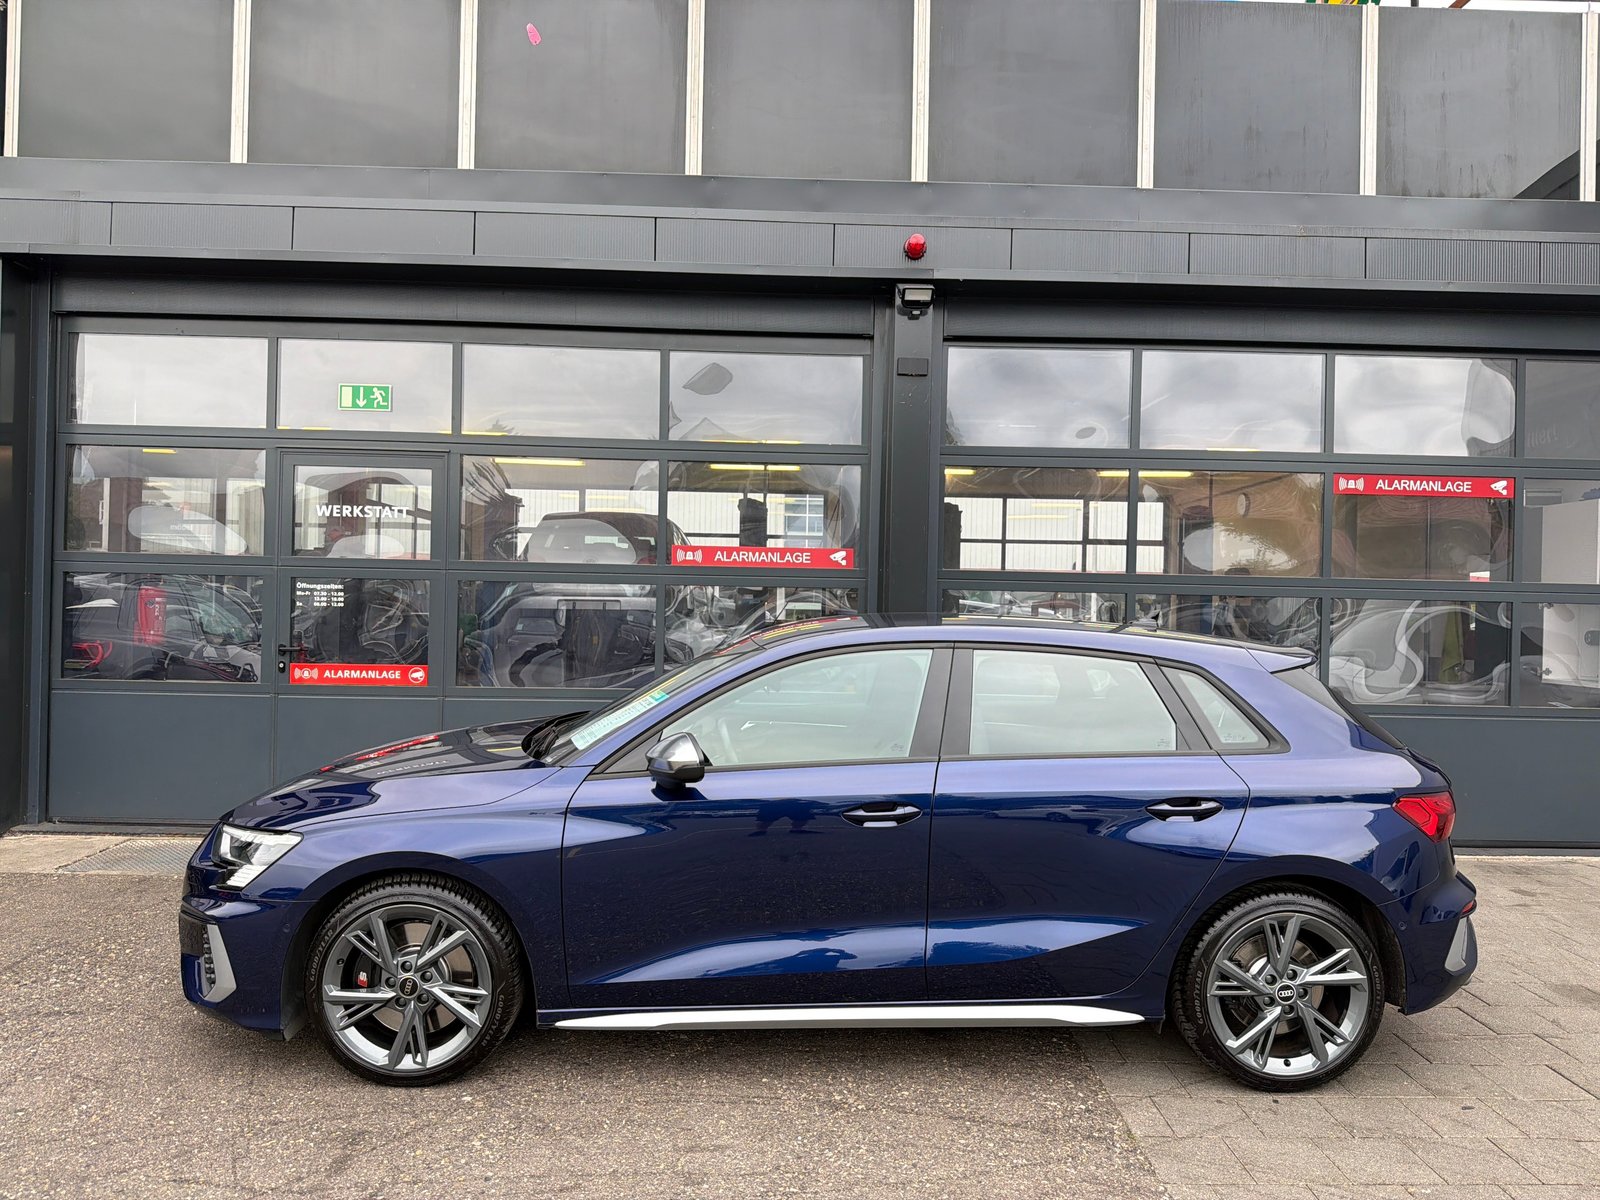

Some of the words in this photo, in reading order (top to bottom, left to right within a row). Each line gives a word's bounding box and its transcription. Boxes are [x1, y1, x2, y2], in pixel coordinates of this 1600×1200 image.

[1376, 479, 1472, 493] ALARMANLAGE
[316, 504, 409, 519] WERKSTATT
[714, 550, 811, 564] ALARMANLAGE
[324, 670, 401, 679] ALARMANLAGE
